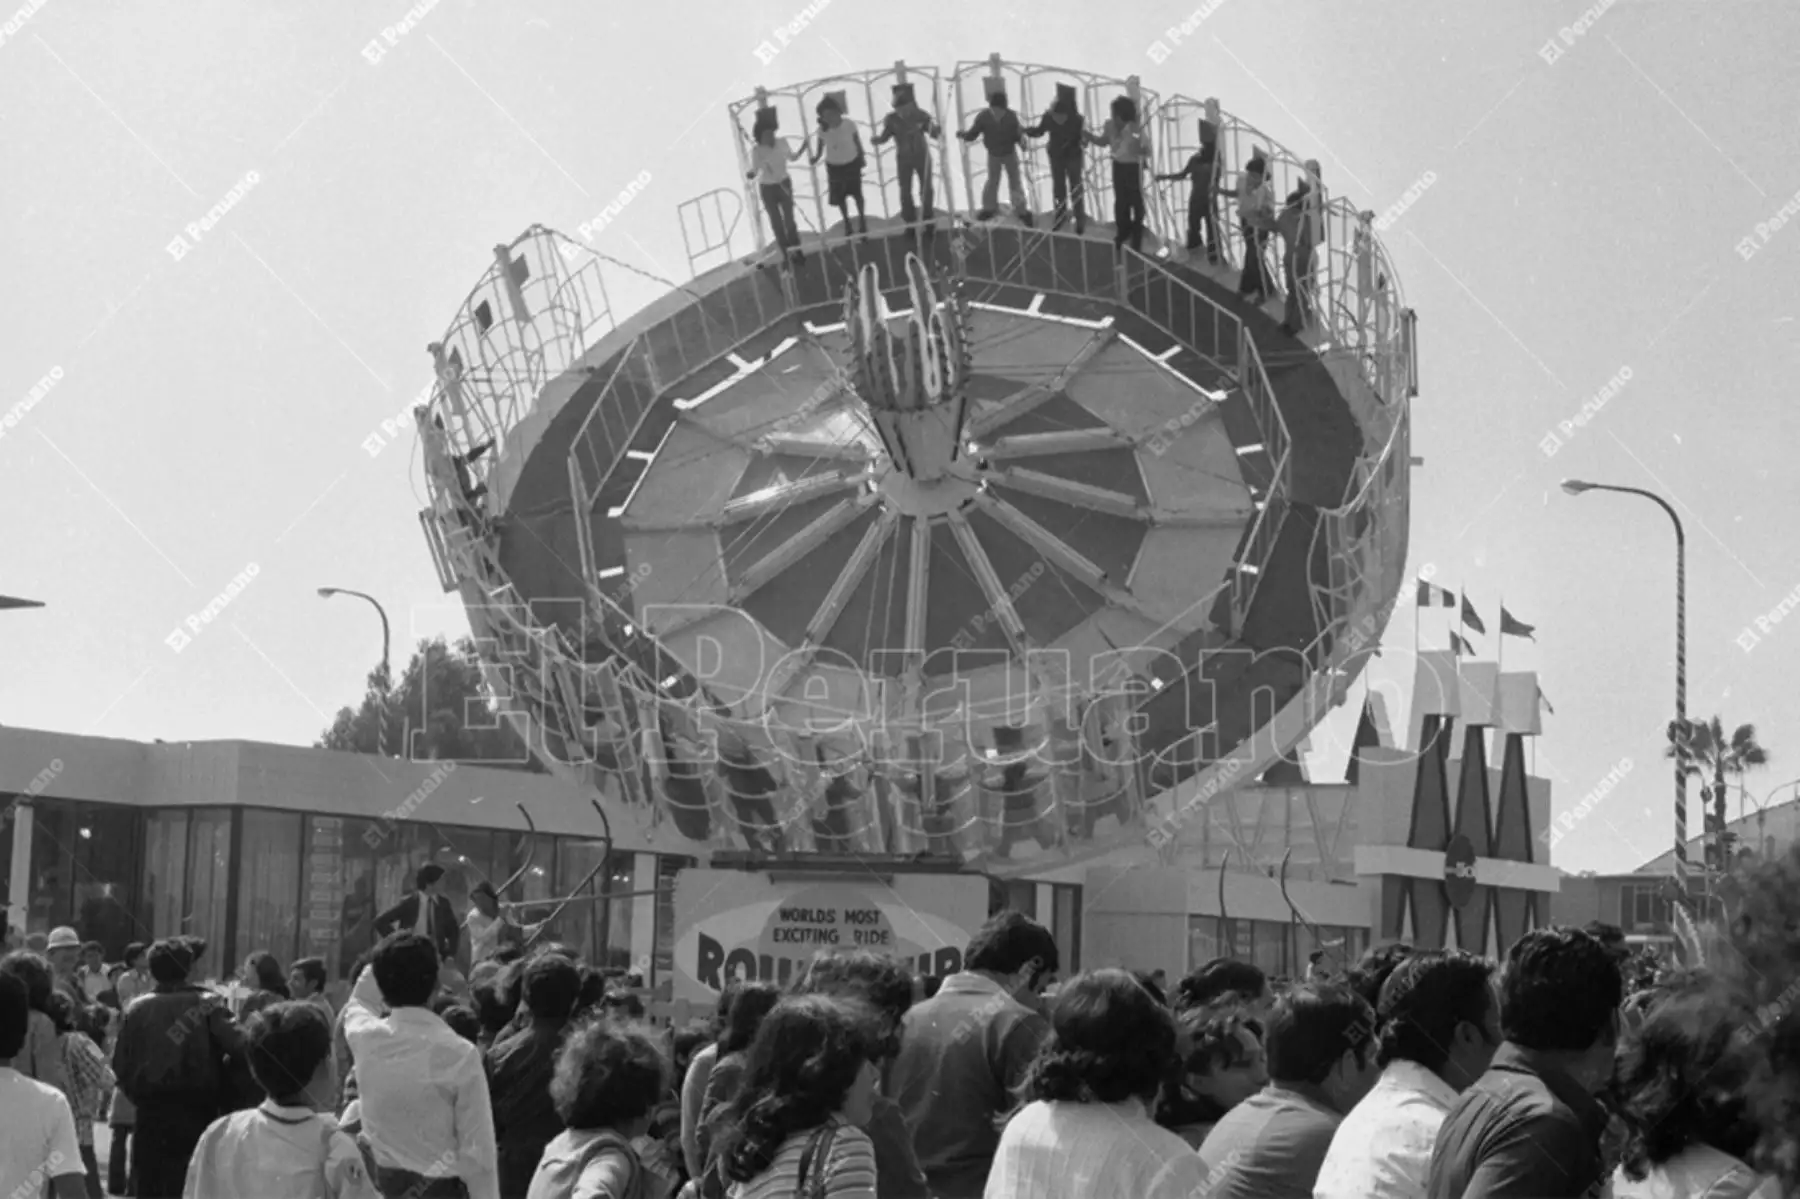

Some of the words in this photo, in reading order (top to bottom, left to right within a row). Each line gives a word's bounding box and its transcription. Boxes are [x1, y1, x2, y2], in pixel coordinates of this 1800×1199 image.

[844, 909, 881, 924] MOST
[773, 927, 839, 944] EXCITING
[853, 929, 889, 945] RIDE
